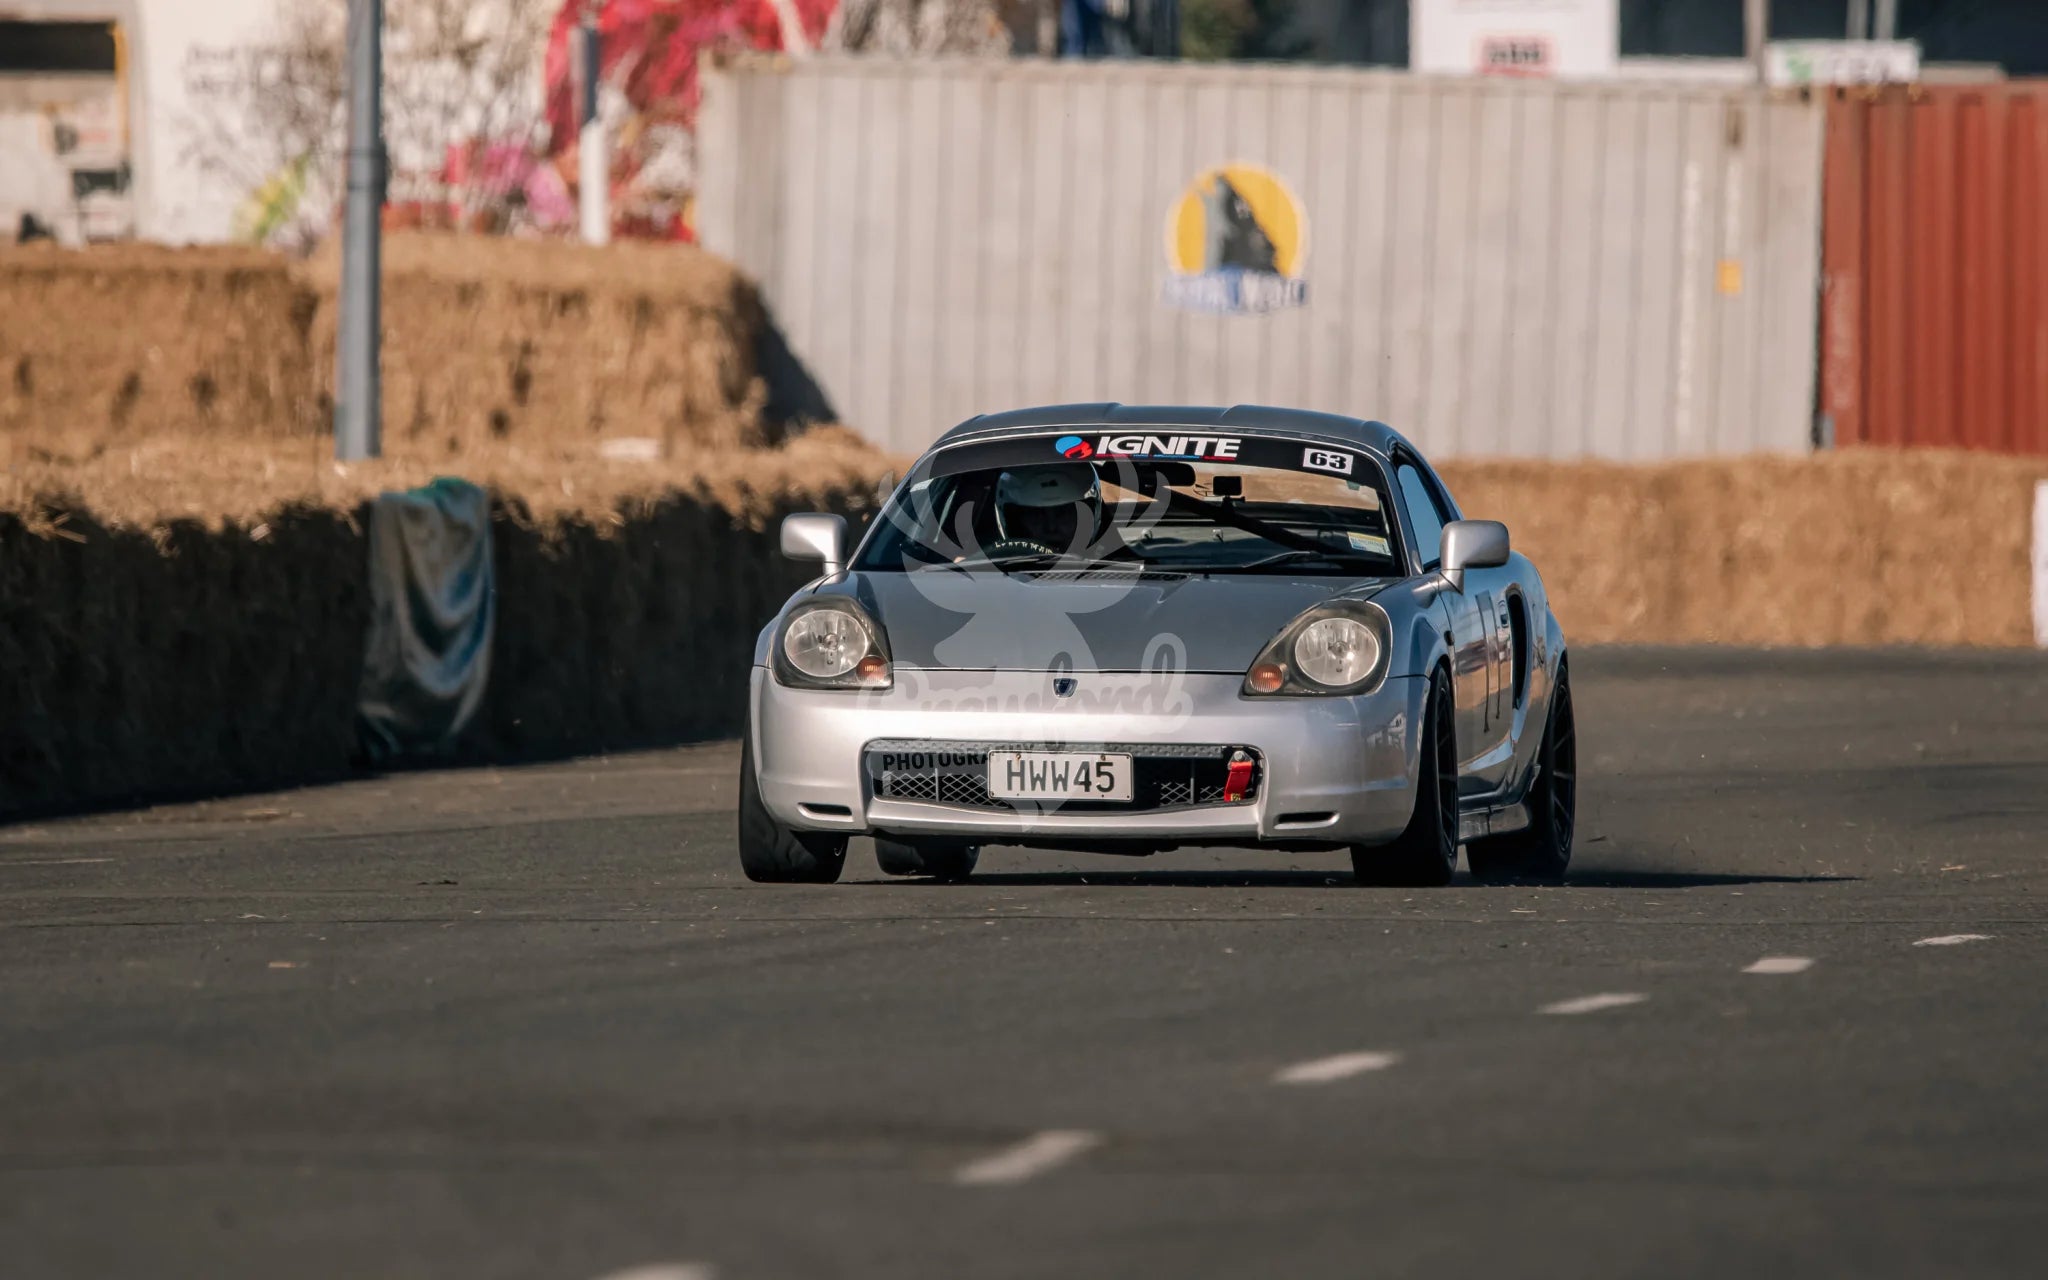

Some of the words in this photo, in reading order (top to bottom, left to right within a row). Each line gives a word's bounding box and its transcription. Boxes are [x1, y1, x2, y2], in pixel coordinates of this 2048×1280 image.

[1096, 435, 1242, 458] IGNITE
[1310, 451, 1347, 470] 63
[1006, 759, 1116, 793] HWW45
